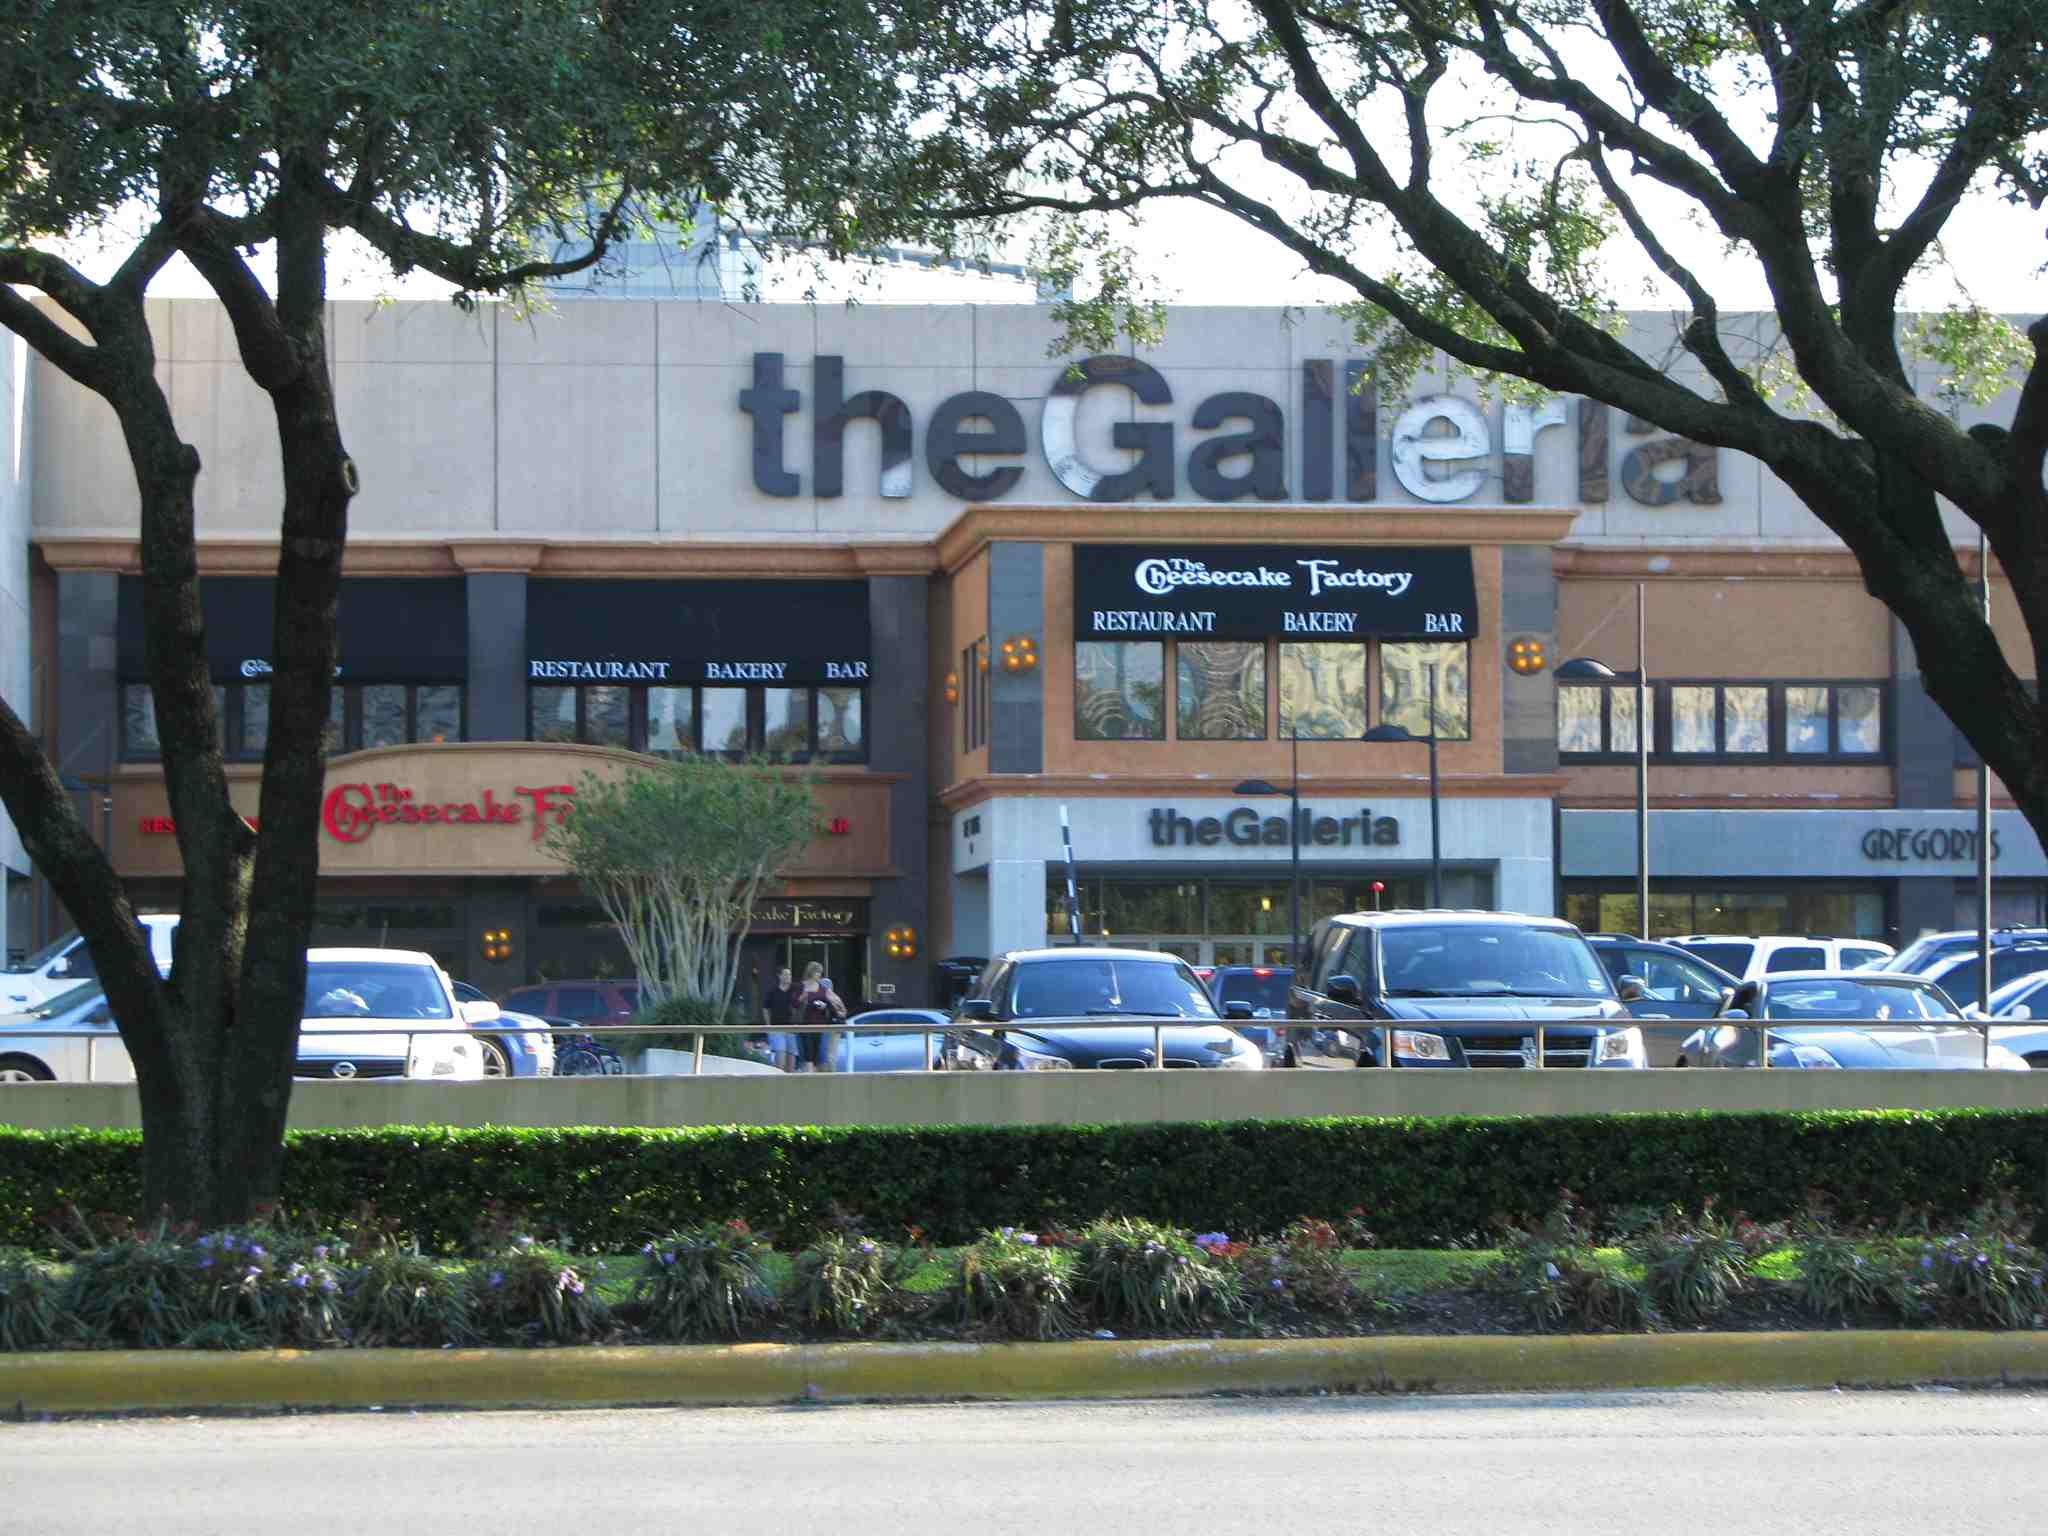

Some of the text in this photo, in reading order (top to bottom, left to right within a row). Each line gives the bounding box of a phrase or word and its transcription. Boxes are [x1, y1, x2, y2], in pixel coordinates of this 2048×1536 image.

[1169, 559, 1206, 572] The
[1135, 559, 1412, 596] Cheesecake Factory
[1093, 611, 1464, 632] RESTAURANT BAKERY BAR
[530, 661, 869, 679] RESTAURANT BAKERY BAR
[322, 783, 521, 843] Cheesecake
